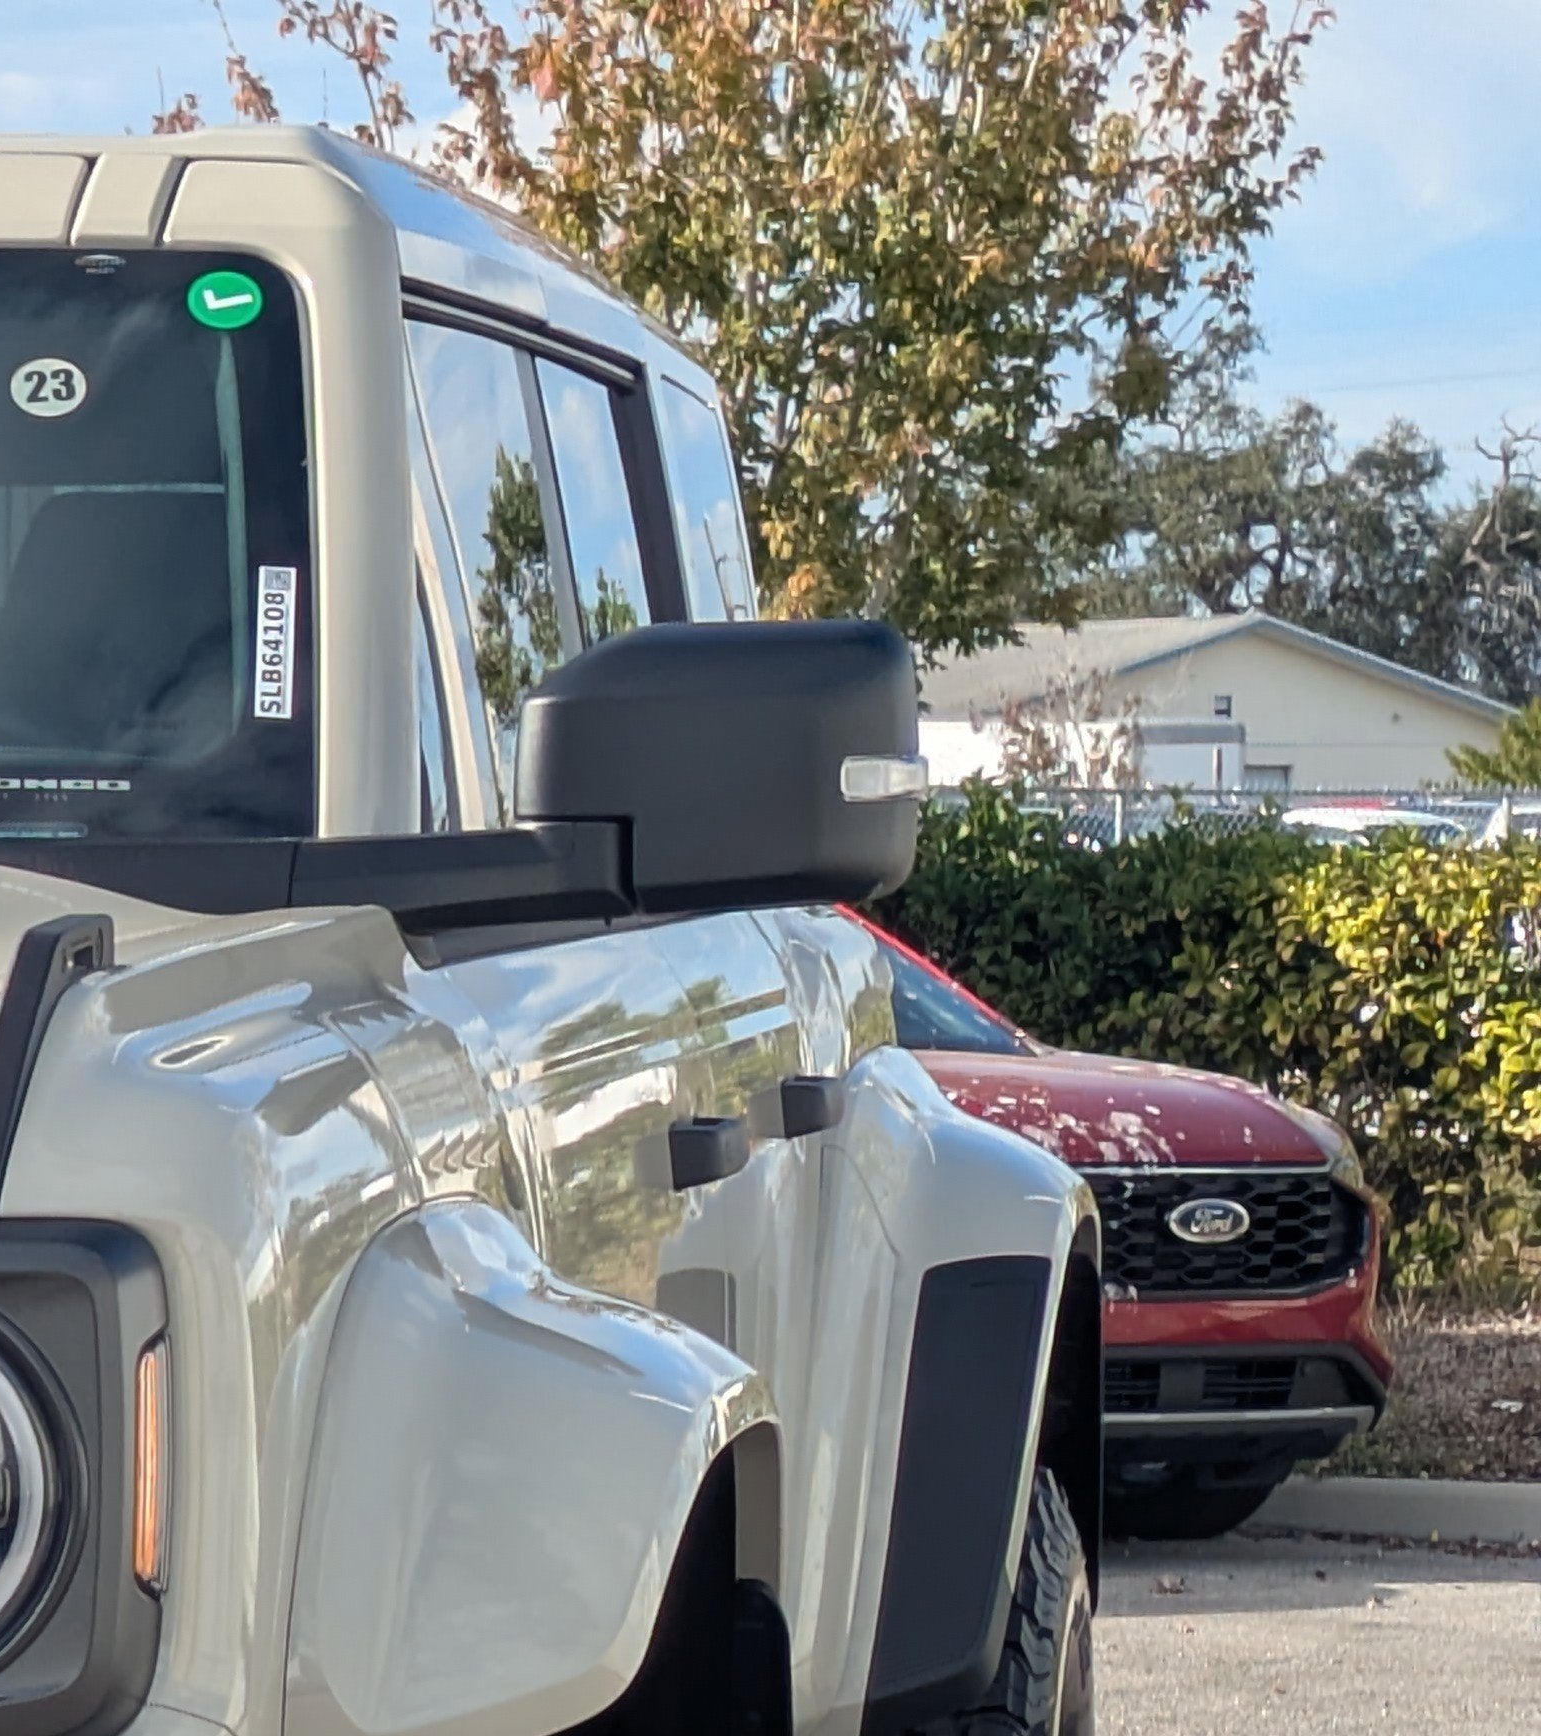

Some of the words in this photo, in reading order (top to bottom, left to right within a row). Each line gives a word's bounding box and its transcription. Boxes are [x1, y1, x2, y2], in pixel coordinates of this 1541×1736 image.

[23, 368, 77, 403] 23
[259, 592, 285, 714] SLB64108
[1190, 1208, 1234, 1233] Ford
